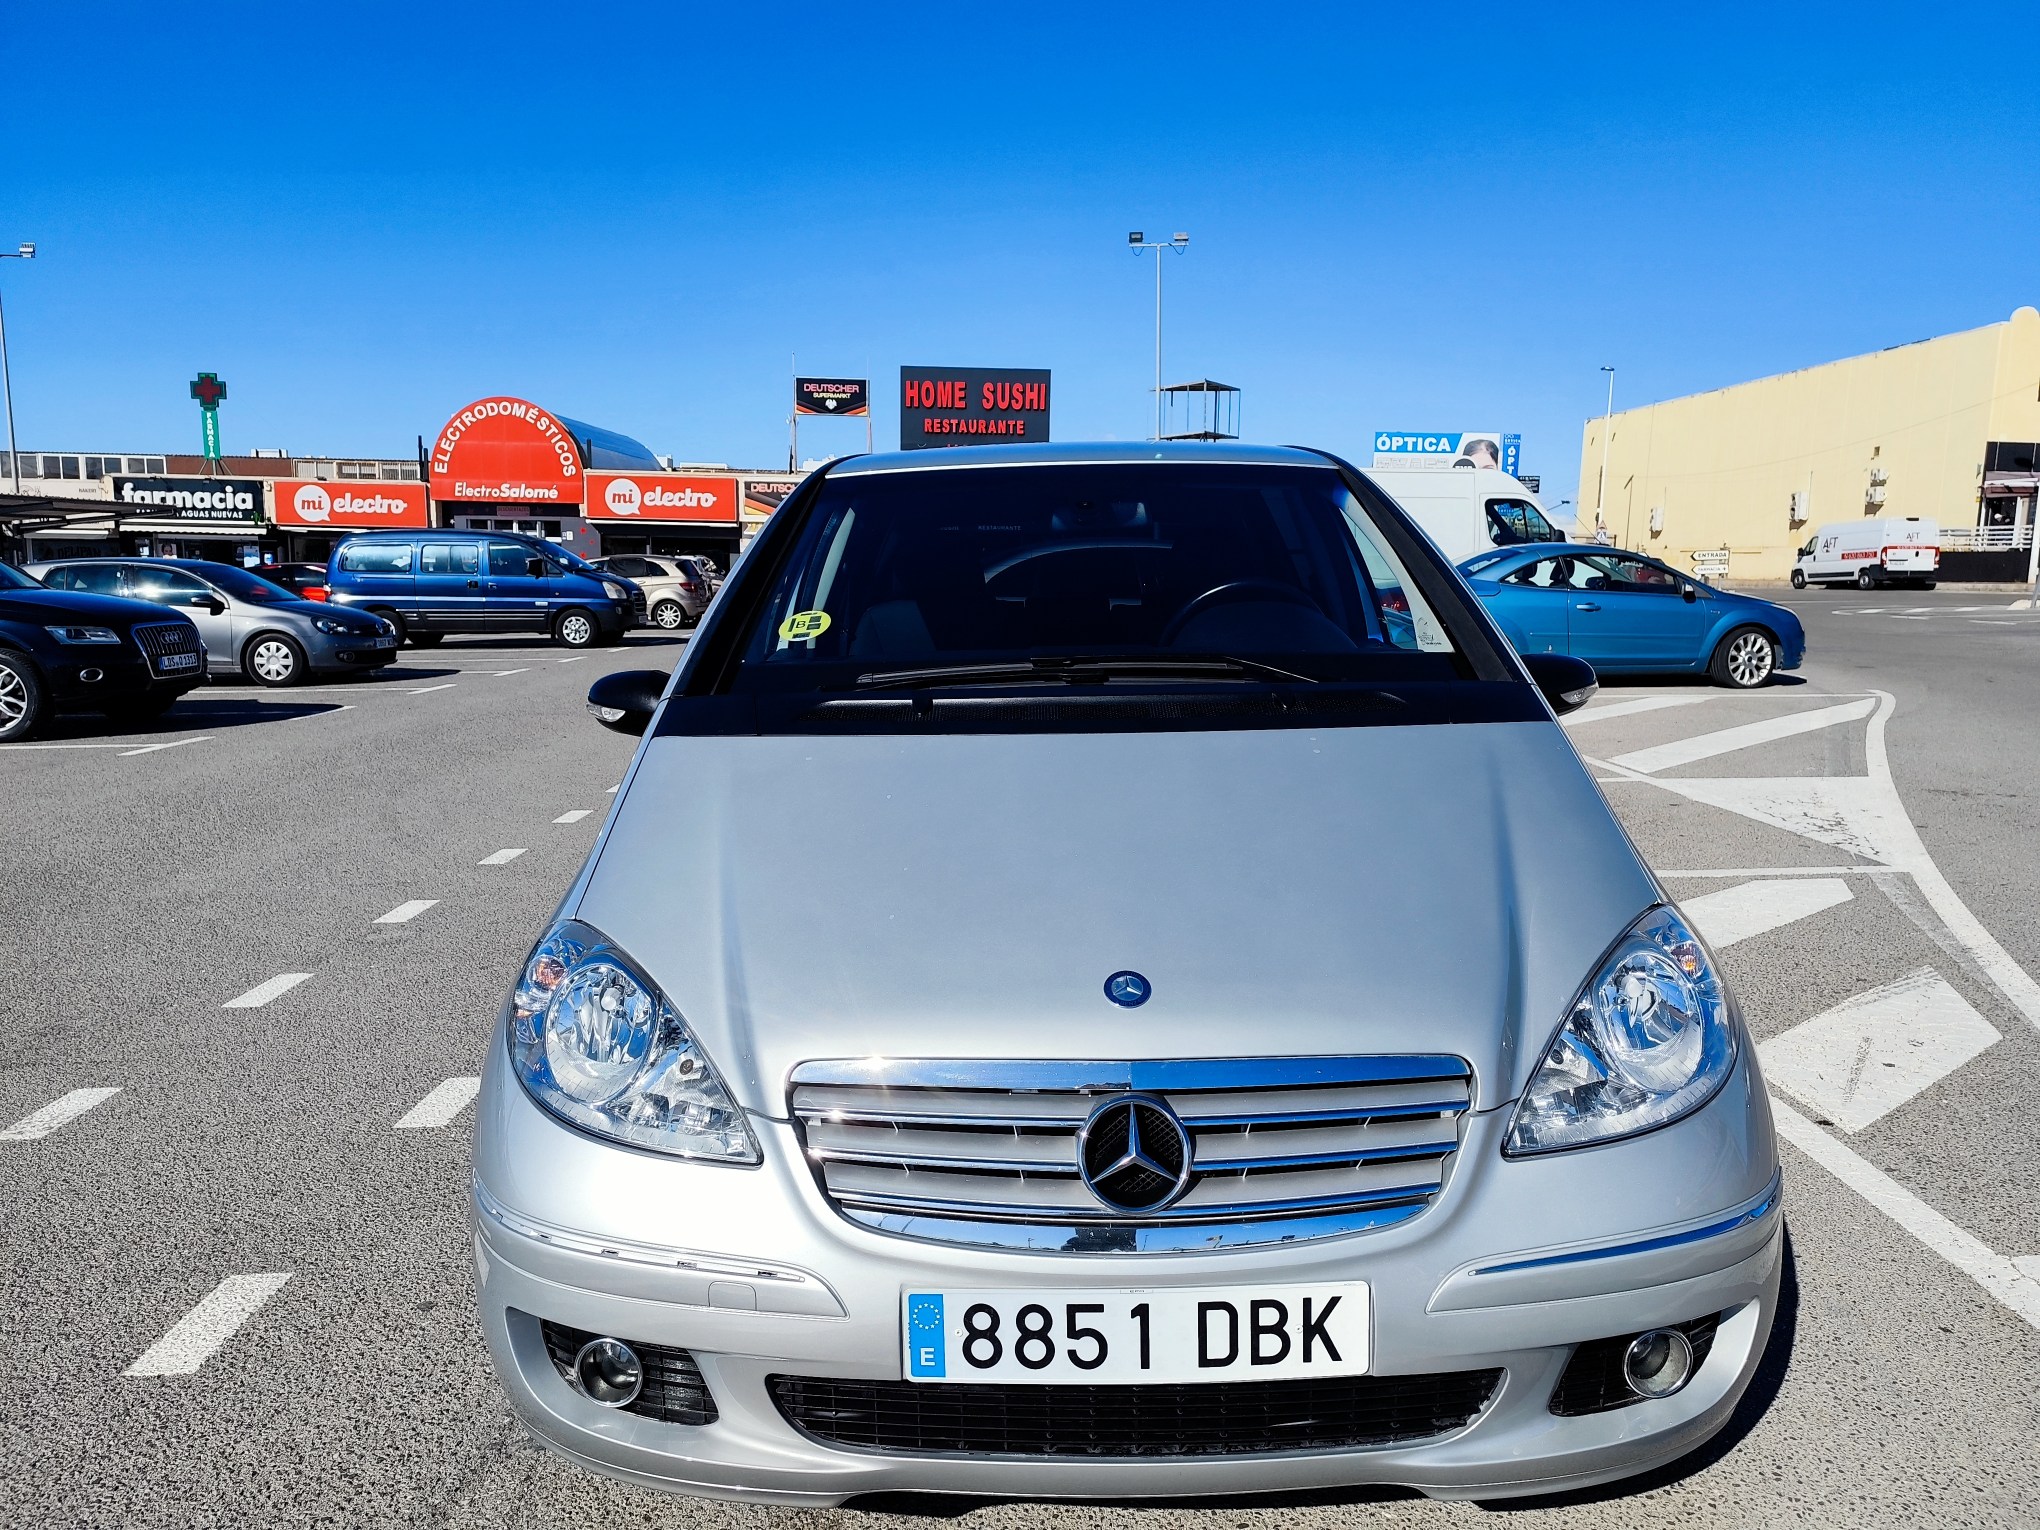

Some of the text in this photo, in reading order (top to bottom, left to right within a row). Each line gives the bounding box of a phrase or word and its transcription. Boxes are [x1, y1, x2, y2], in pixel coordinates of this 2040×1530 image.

[803, 383, 859, 393] DEUTSCHER
[905, 380, 1046, 410] HOME SUSHI
[206, 411, 216, 458] FARMACIA
[924, 418, 1025, 435] RESTAURANTE
[434, 401, 577, 477] ELECTRODOMÉSTICOS
[1376, 433, 1452, 452] ÓPTICA
[121, 482, 254, 510] farmacia
[454, 481, 559, 499] ElectroSalomé
[611, 485, 718, 508] mi electro
[750, 483, 796, 493] DEUTSC
[301, 492, 408, 515] mi electro
[181, 509, 243, 519] AGUAS NUEVAS
[1906, 532, 1920, 540] AFT
[962, 1295, 1343, 1371] 8851 DBK
[919, 1347, 936, 1366] E
